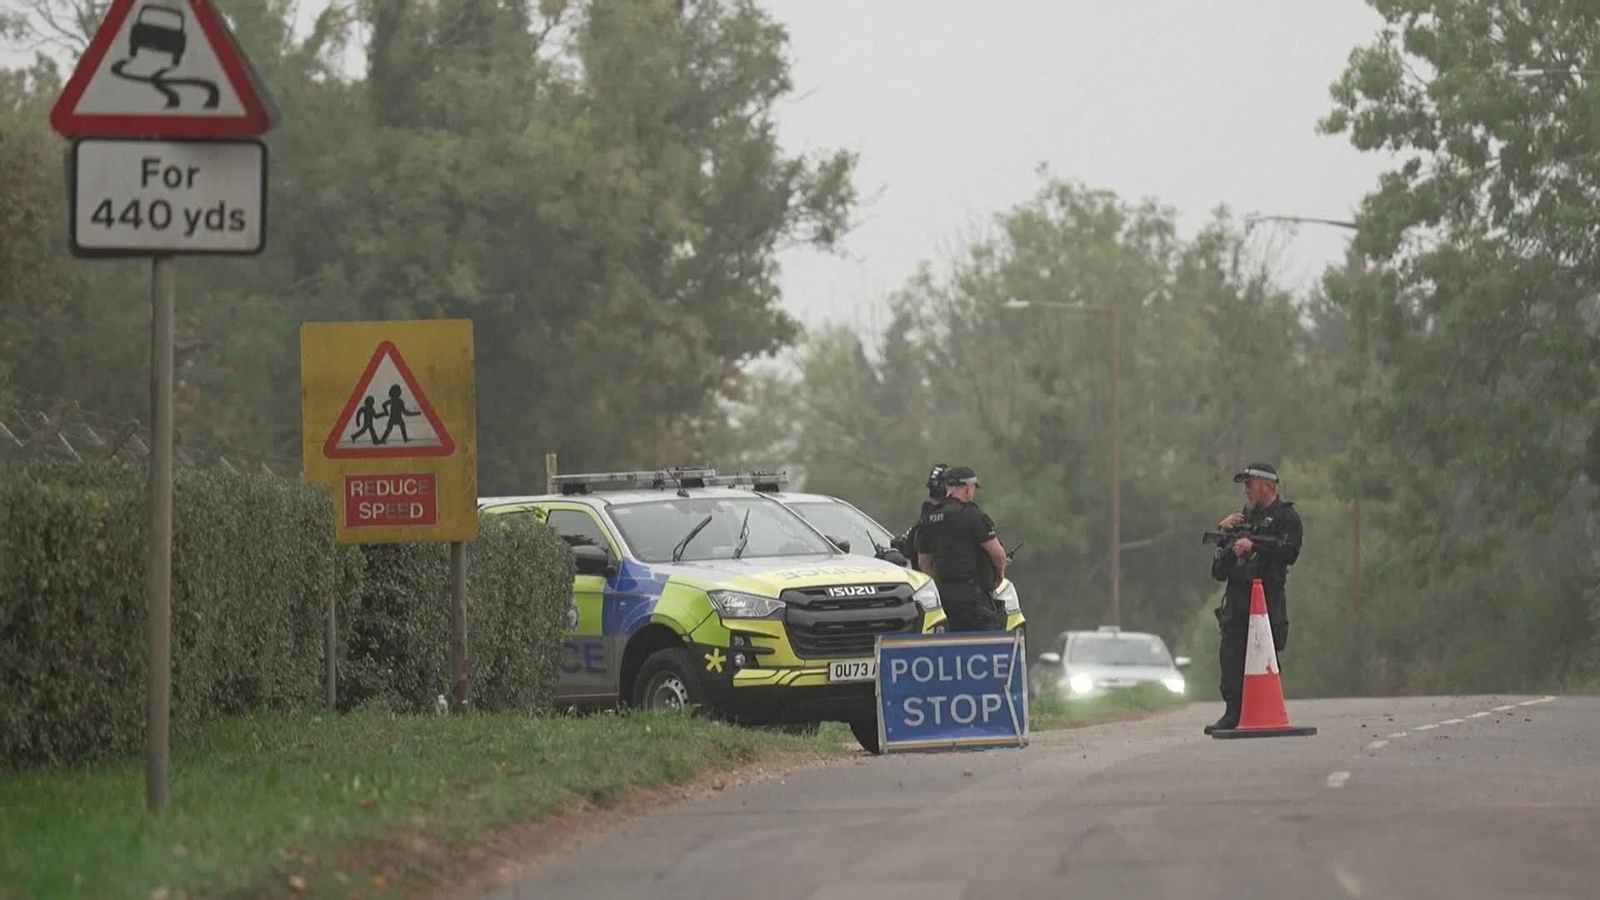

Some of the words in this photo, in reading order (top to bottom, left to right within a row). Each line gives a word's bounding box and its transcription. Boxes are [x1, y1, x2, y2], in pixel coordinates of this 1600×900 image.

[141, 157, 200, 189] For
[91, 198, 171, 231] 440
[183, 200, 246, 237] yds
[350, 478, 428, 498] REDUCE
[359, 501, 424, 520] SPEED
[828, 586, 876, 597] ISUZU
[835, 662, 869, 678] OU73
[890, 653, 1009, 683] POLICE
[903, 693, 1002, 726] STOP
